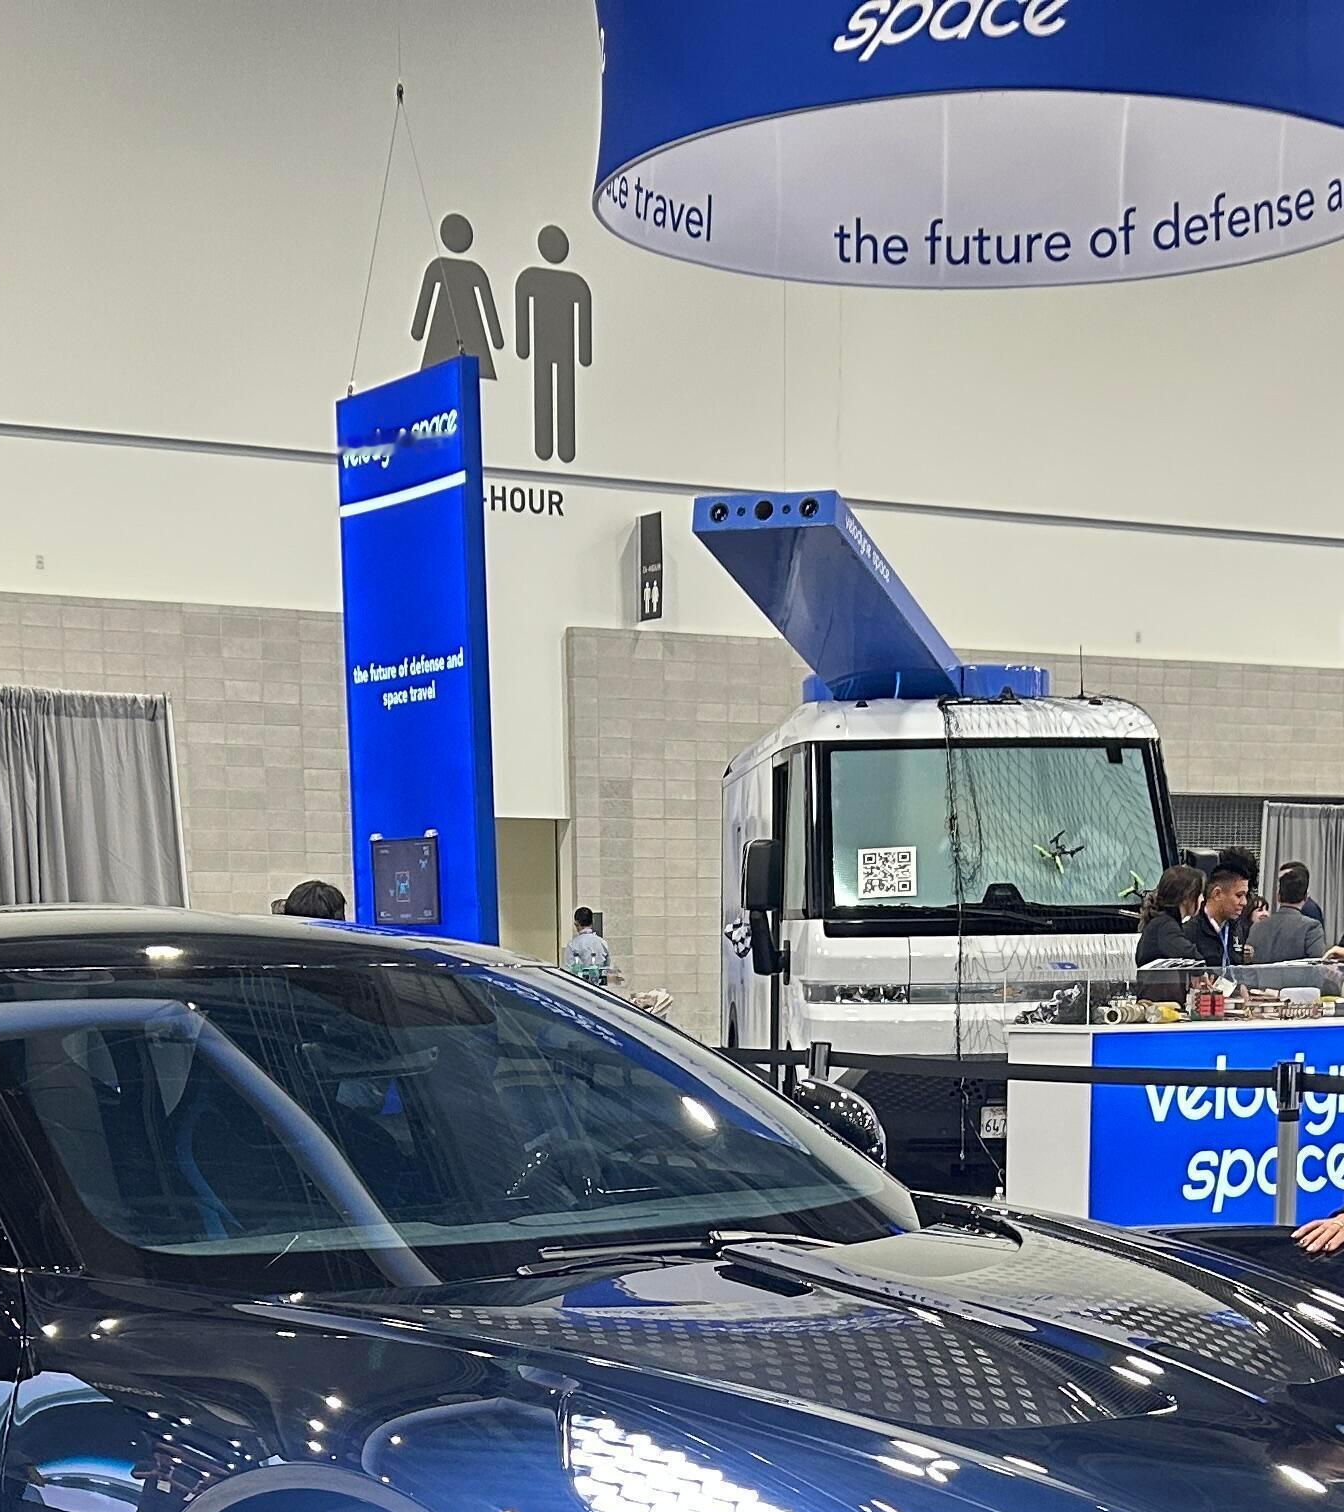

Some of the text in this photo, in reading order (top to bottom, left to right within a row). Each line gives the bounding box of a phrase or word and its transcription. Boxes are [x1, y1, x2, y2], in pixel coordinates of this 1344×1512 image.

[634, 177, 713, 242] travel
[834, 217, 909, 265] the
[924, 218, 1072, 266] future
[1089, 207, 1136, 258] of
[1153, 192, 1315, 250] defense
[353, 646, 464, 684] the future of defense and
[382, 679, 436, 711] space travel
